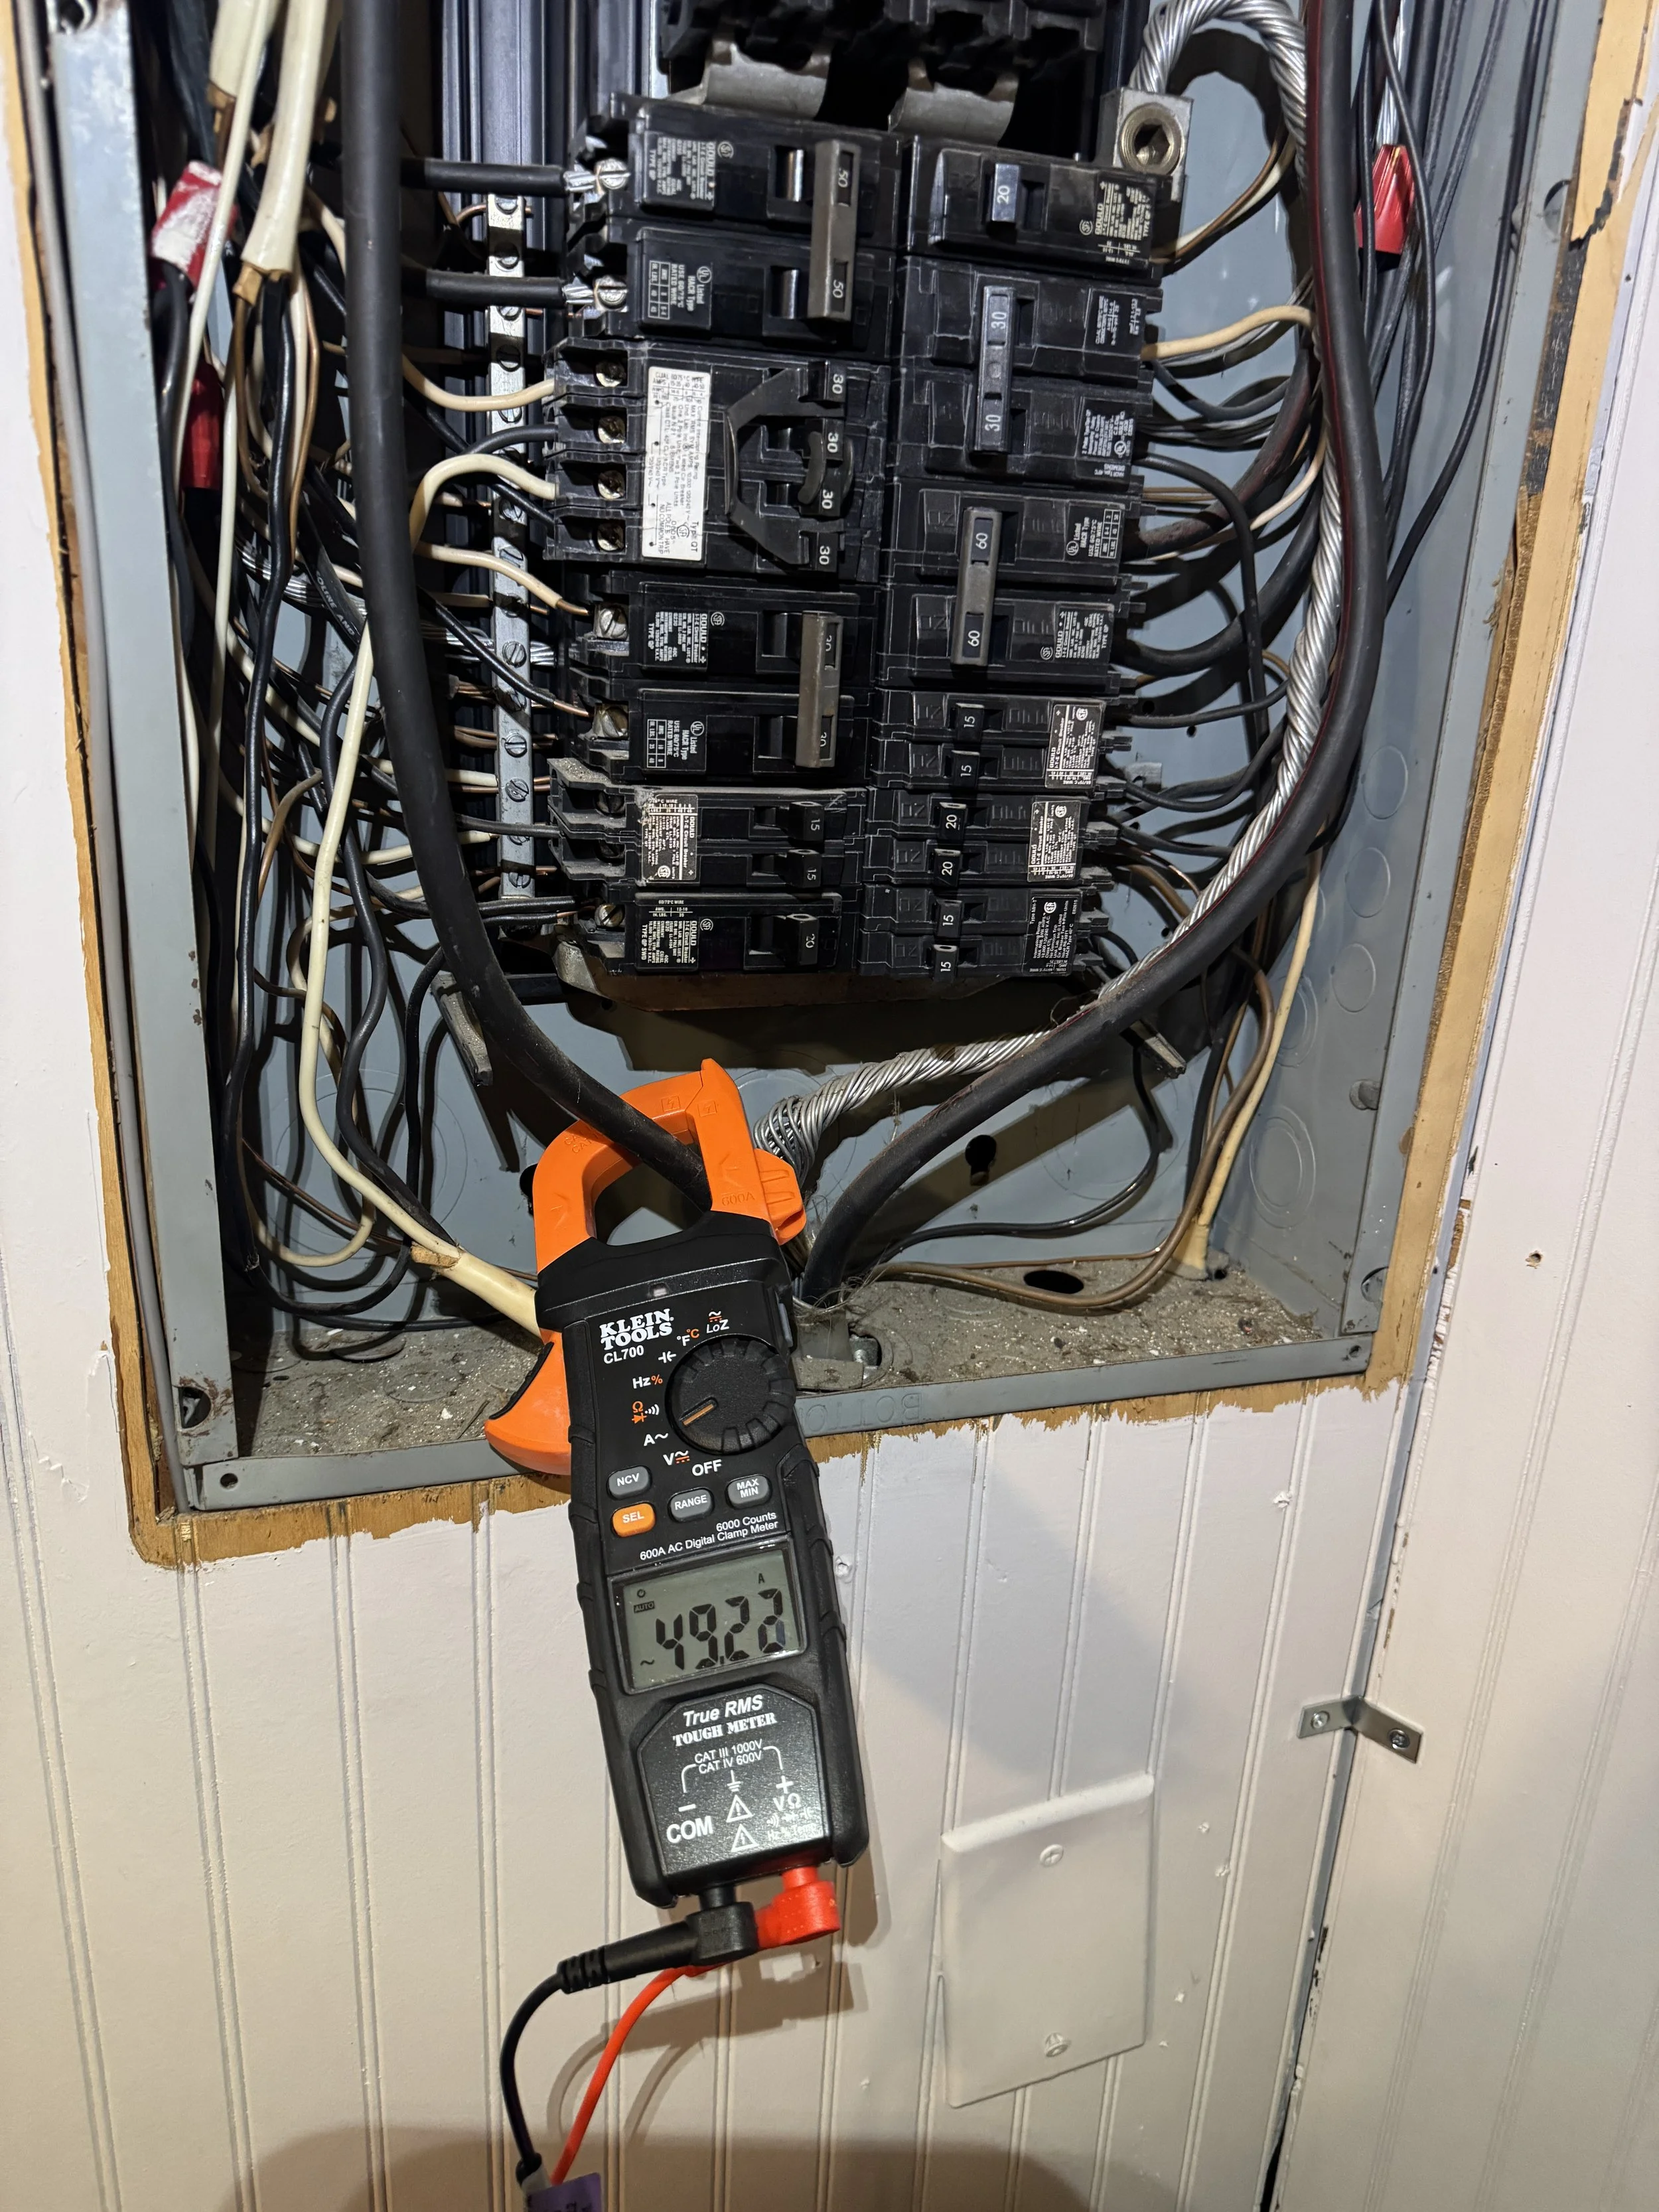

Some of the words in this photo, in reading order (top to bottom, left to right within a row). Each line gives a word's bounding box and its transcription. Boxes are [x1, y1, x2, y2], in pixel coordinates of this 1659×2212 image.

[837, 169, 849, 188] 50
[997, 185, 1010, 204] 20
[833, 279, 844, 299] 50
[686, 296, 695, 311] Type
[991, 311, 1007, 331] 30
[832, 374, 843, 394] 30
[985, 413, 1001, 432] 30
[828, 433, 839, 453] 30
[822, 489, 833, 510] 30
[691, 542, 697, 552] QT
[975, 533, 988, 550] 60
[820, 546, 830, 565] 30
[968, 630, 980, 647] 60
[964, 715, 975, 728] 15
[960, 765, 972, 777] 15
[810, 818, 820, 831] 15
[946, 814, 957, 830] 20
[807, 869, 816, 881] 15
[942, 861, 953, 876] 20
[942, 915, 954, 926] 15
[806, 934, 815, 948] 20
[941, 962, 952, 973] 15
[721, 1191, 755, 1207] 600A
[600, 1309, 671, 1338] KLEIN
[706, 1319, 729, 1333] LoZ
[601, 1322, 672, 1350] TOOLS
[604, 1345, 644, 1364] CL700
[692, 1459, 722, 1476] OFF
[617, 1473, 640, 1487] NCV
[737, 1478, 759, 1491] MAX
[740, 1486, 758, 1498] MIN
[674, 1495, 707, 1511] RANGE
[622, 1513, 644, 1524] SEL
[716, 1518, 740, 1532] 6000
[742, 1512, 776, 1526] Counts
[640, 1546, 666, 1561] 600A
[667, 1542, 683, 1554] AC
[685, 1534, 715, 1548] Digital
[717, 1528, 748, 1542] Clamp
[750, 1520, 778, 1534] Meter
[758, 1573, 765, 1584] A
[634, 1601, 655, 1613] AUTO
[684, 1708, 720, 1727] True
[725, 1694, 763, 1718] RMS
[673, 1724, 723, 1747] TOUGH
[726, 1712, 778, 1734] METER
[694, 1749, 716, 1763] CAT
[719, 1747, 729, 1758] III
[731, 1739, 762, 1755] 1000V
[699, 1761, 720, 1774] CAT
[723, 1758, 733, 1768] IV
[737, 1750, 762, 1765] 600V
[666, 1815, 713, 1844] COM
[792, 1823, 816, 1834] Temp
